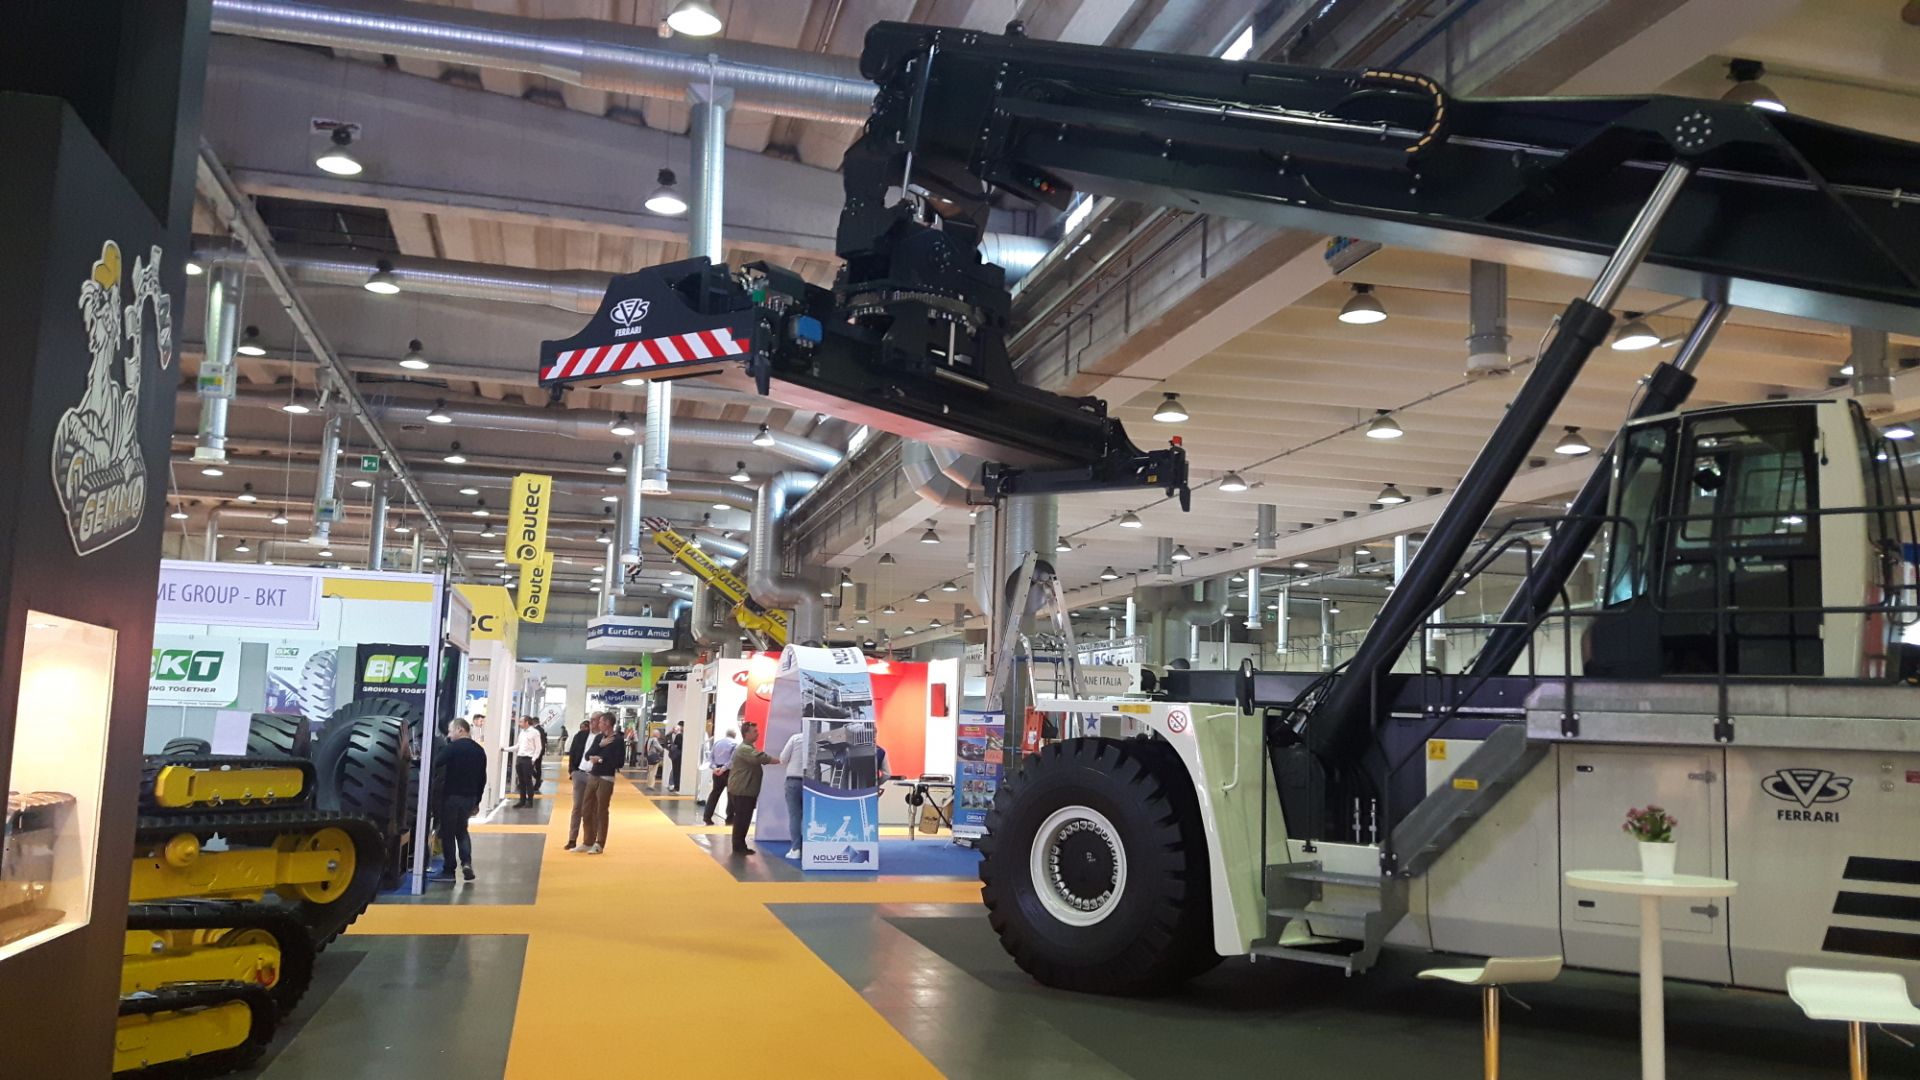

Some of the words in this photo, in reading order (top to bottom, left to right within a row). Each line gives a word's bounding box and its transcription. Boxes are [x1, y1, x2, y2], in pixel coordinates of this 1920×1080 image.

[610, 298, 650, 327] CVS
[615, 325, 642, 337] FERRARI
[523, 483, 541, 542] autec
[529, 560, 544, 604] aute
[182, 584, 239, 604] GROUP
[255, 587, 287, 606] BKT
[607, 627, 643, 636] EuroGru
[647, 630, 670, 638] Amici
[1101, 676, 1121, 687] ITALIA
[1761, 768, 1853, 808] CVS
[1777, 809, 1840, 823] FERRARI
